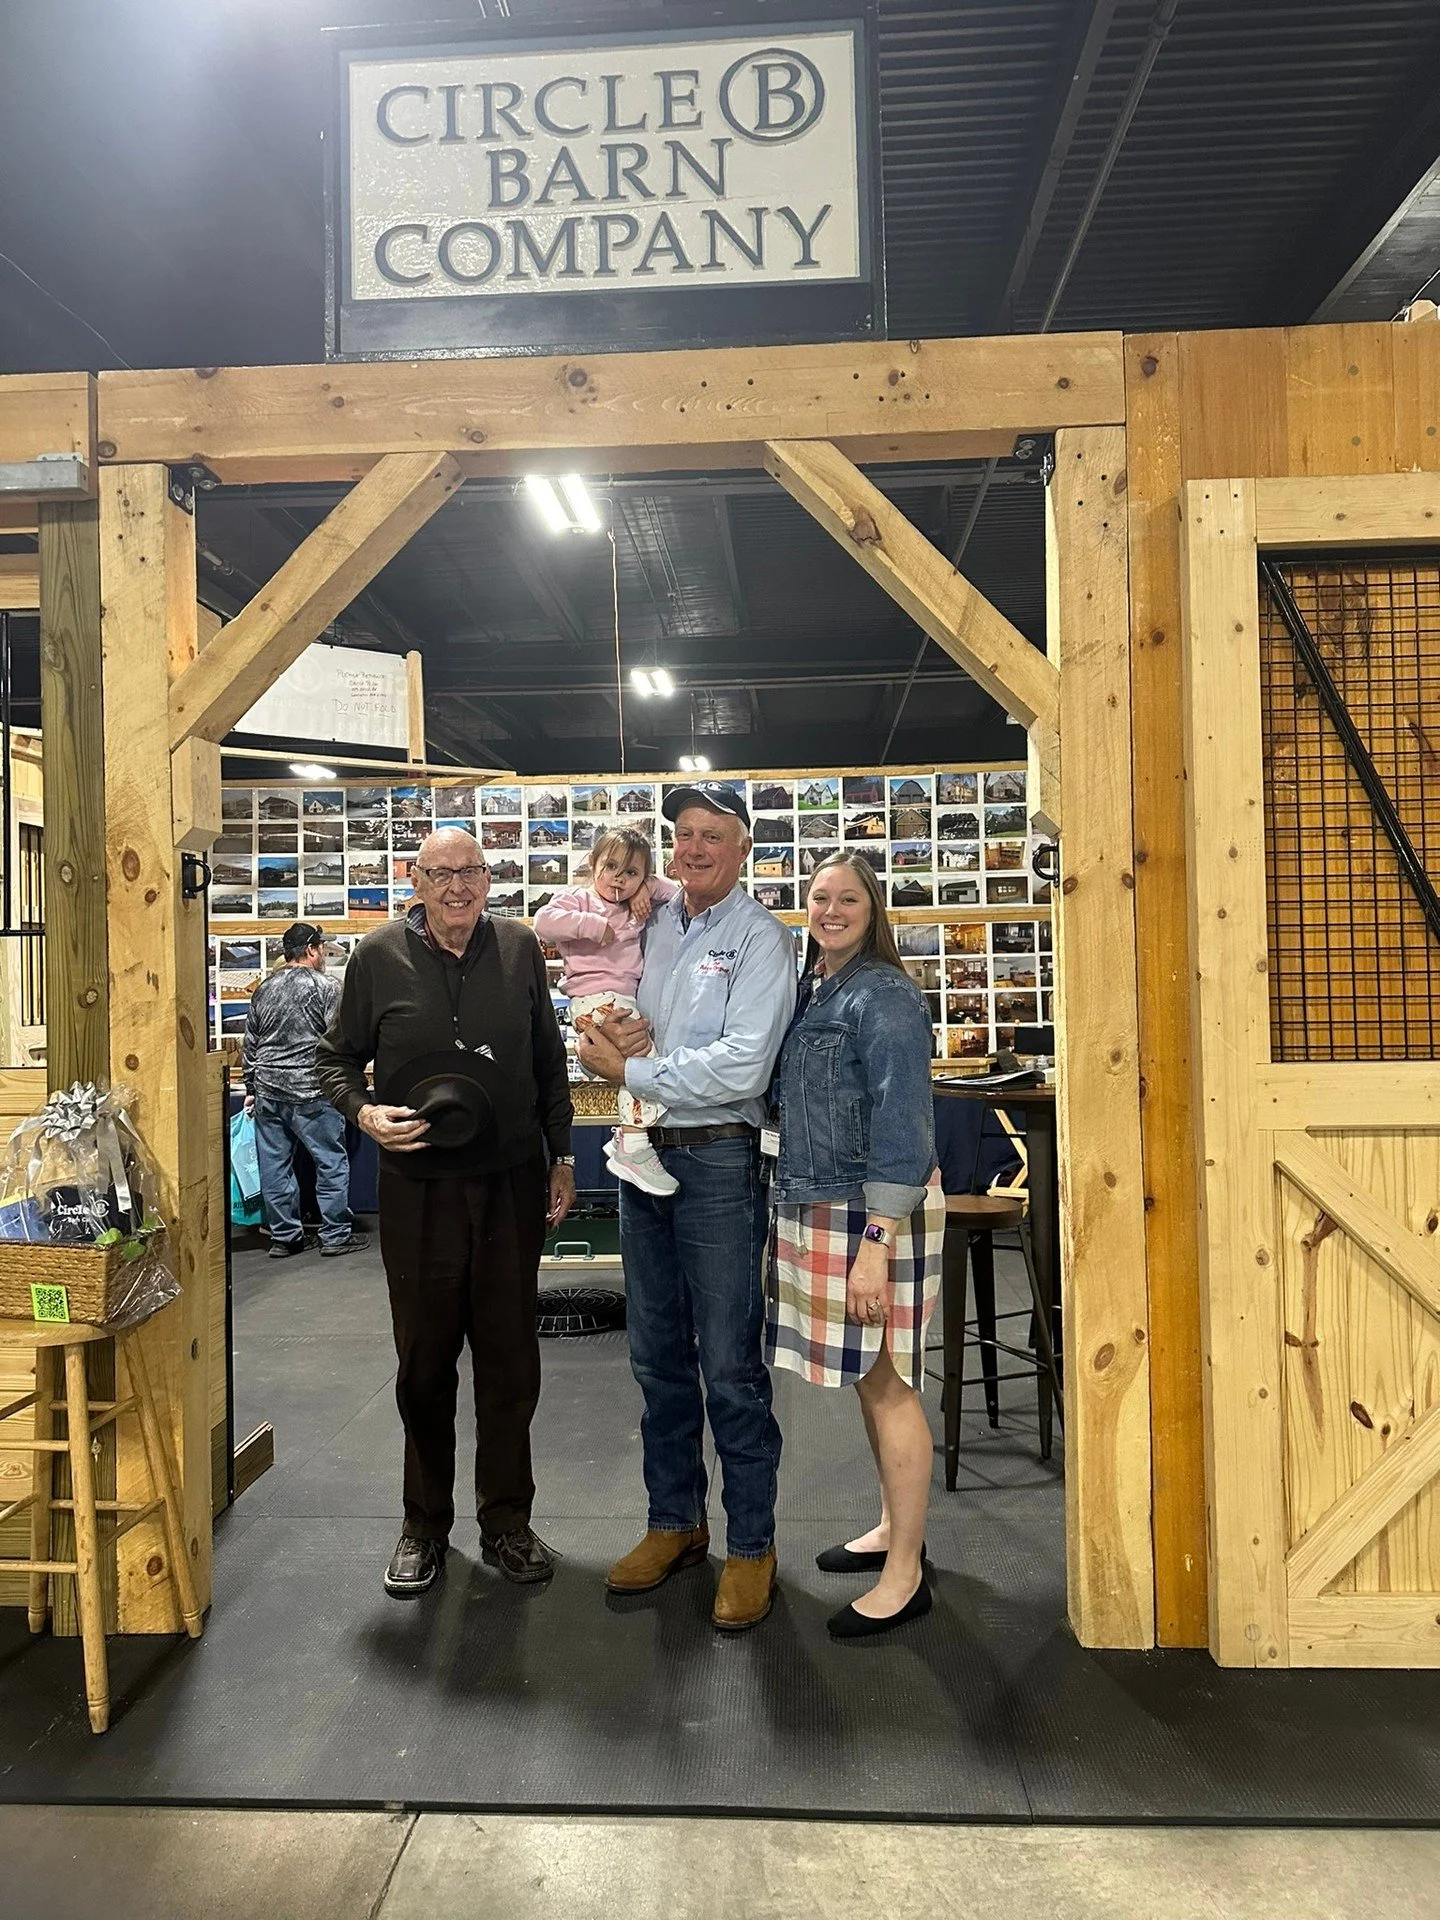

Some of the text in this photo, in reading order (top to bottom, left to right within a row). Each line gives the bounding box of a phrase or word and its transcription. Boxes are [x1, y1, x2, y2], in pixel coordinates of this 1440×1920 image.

[376, 69, 704, 143] CIRCLE
[485, 138, 732, 209] BARN
[374, 204, 832, 286] COMPANY
[354, 702, 372, 711] NOT
[375, 703, 397, 713] FOLD
[57, 1204, 90, 1215] Circle
